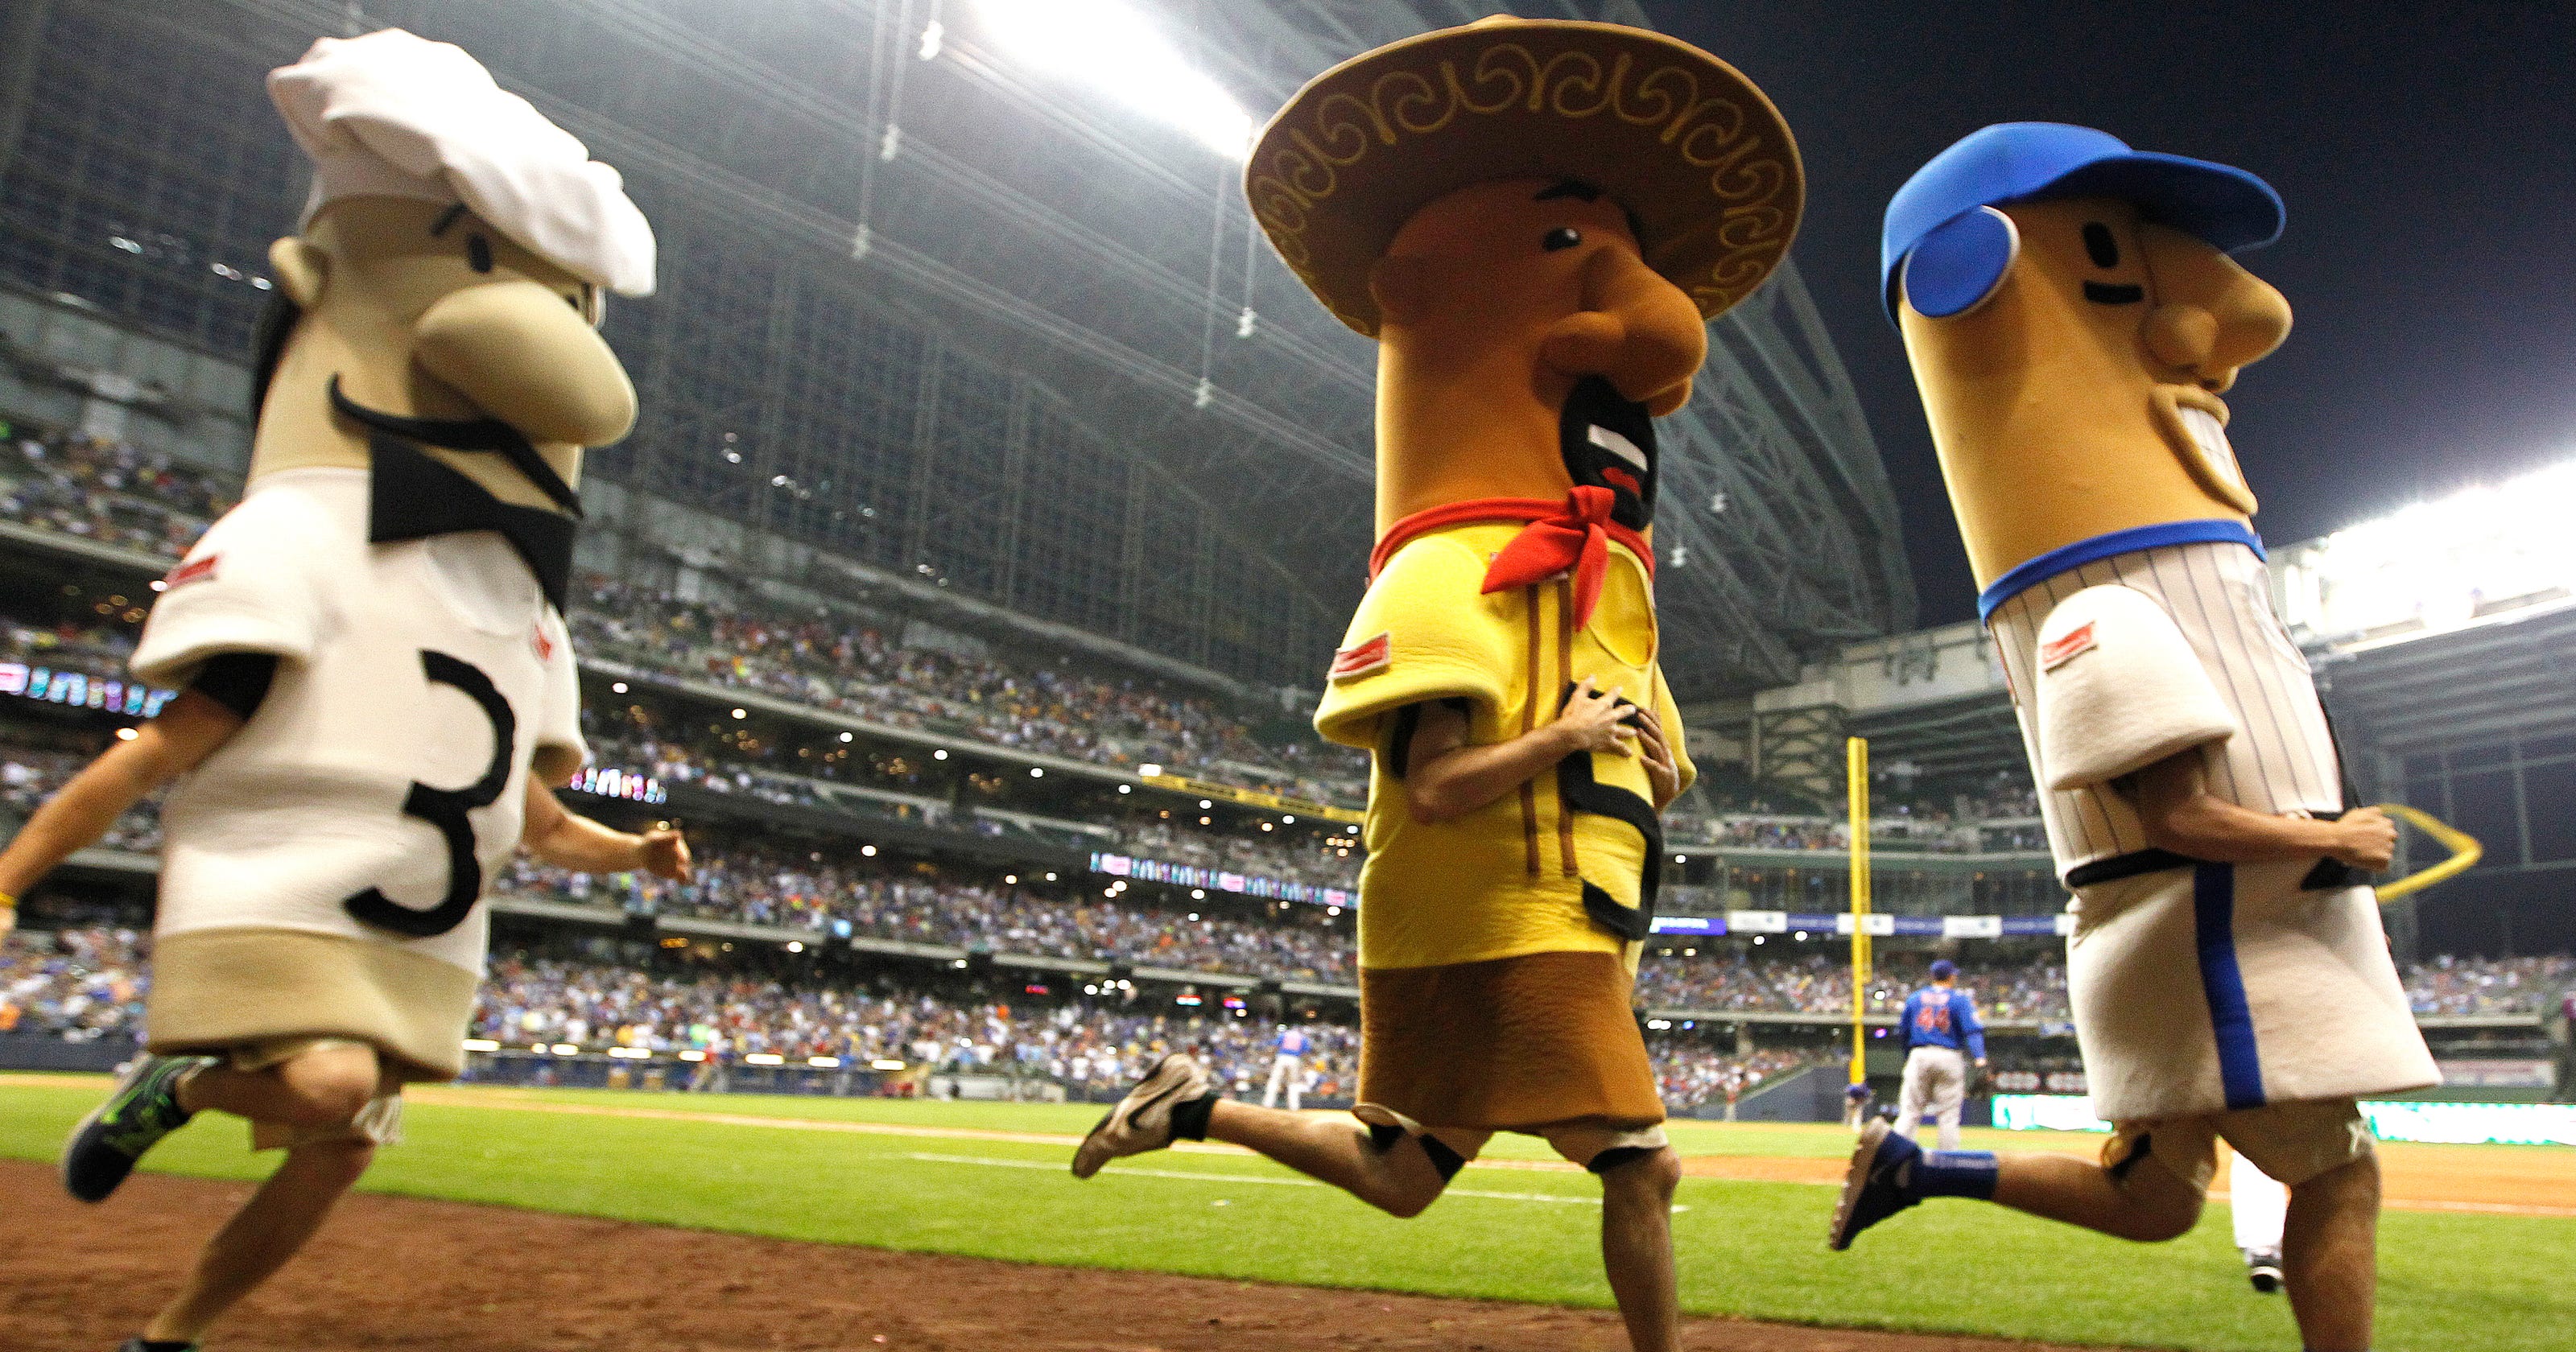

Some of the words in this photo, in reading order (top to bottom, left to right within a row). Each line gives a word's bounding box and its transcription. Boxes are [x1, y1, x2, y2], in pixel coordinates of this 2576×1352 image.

[341, 649, 515, 938] 3
[1557, 680, 1663, 941] 5
[1916, 1006, 1949, 1034] 44
